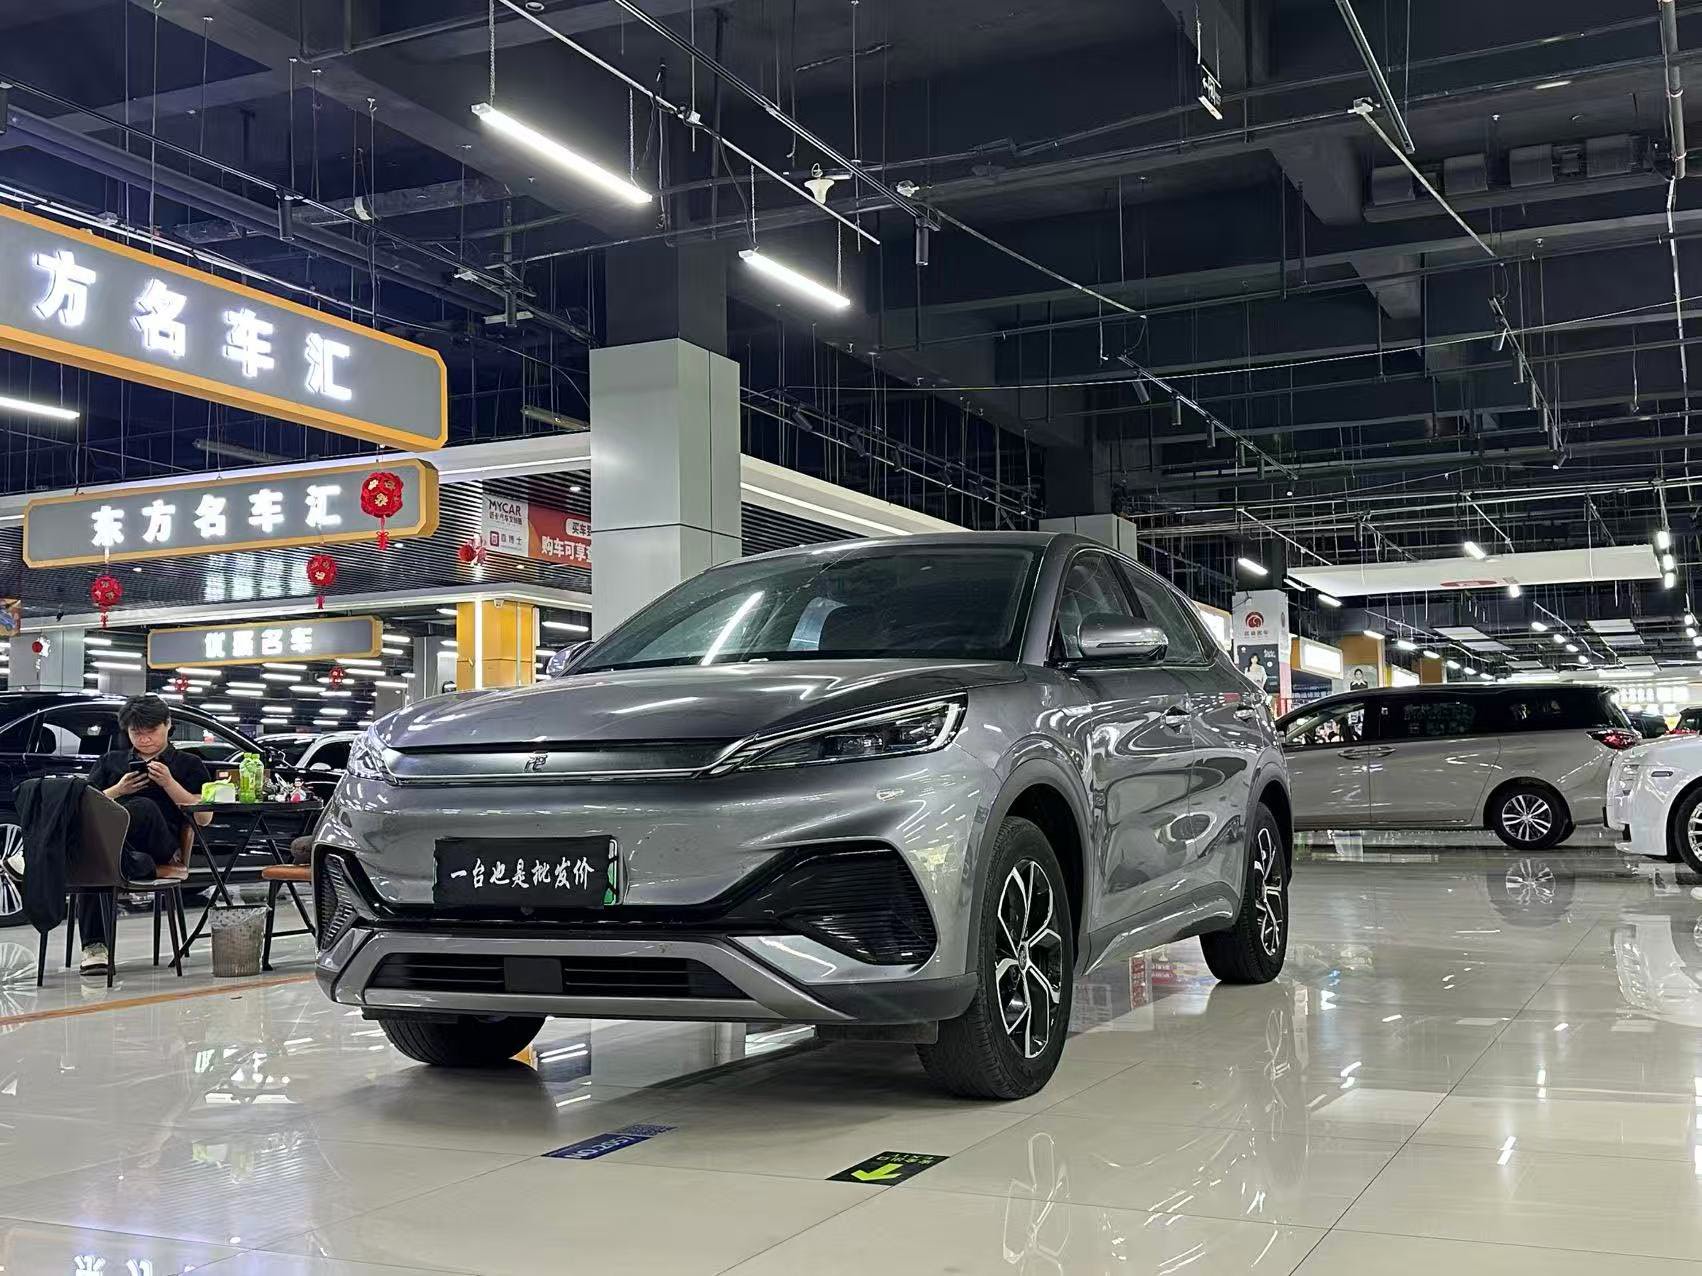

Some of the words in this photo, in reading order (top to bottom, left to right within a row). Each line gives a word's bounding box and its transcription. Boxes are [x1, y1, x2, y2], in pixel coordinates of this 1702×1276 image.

[30, 249, 354, 401] 方名车汇
[91, 484, 343, 547] 东方名车汇
[489, 500, 522, 517] MYCAR
[450, 856, 596, 890] 一台也是批发价
